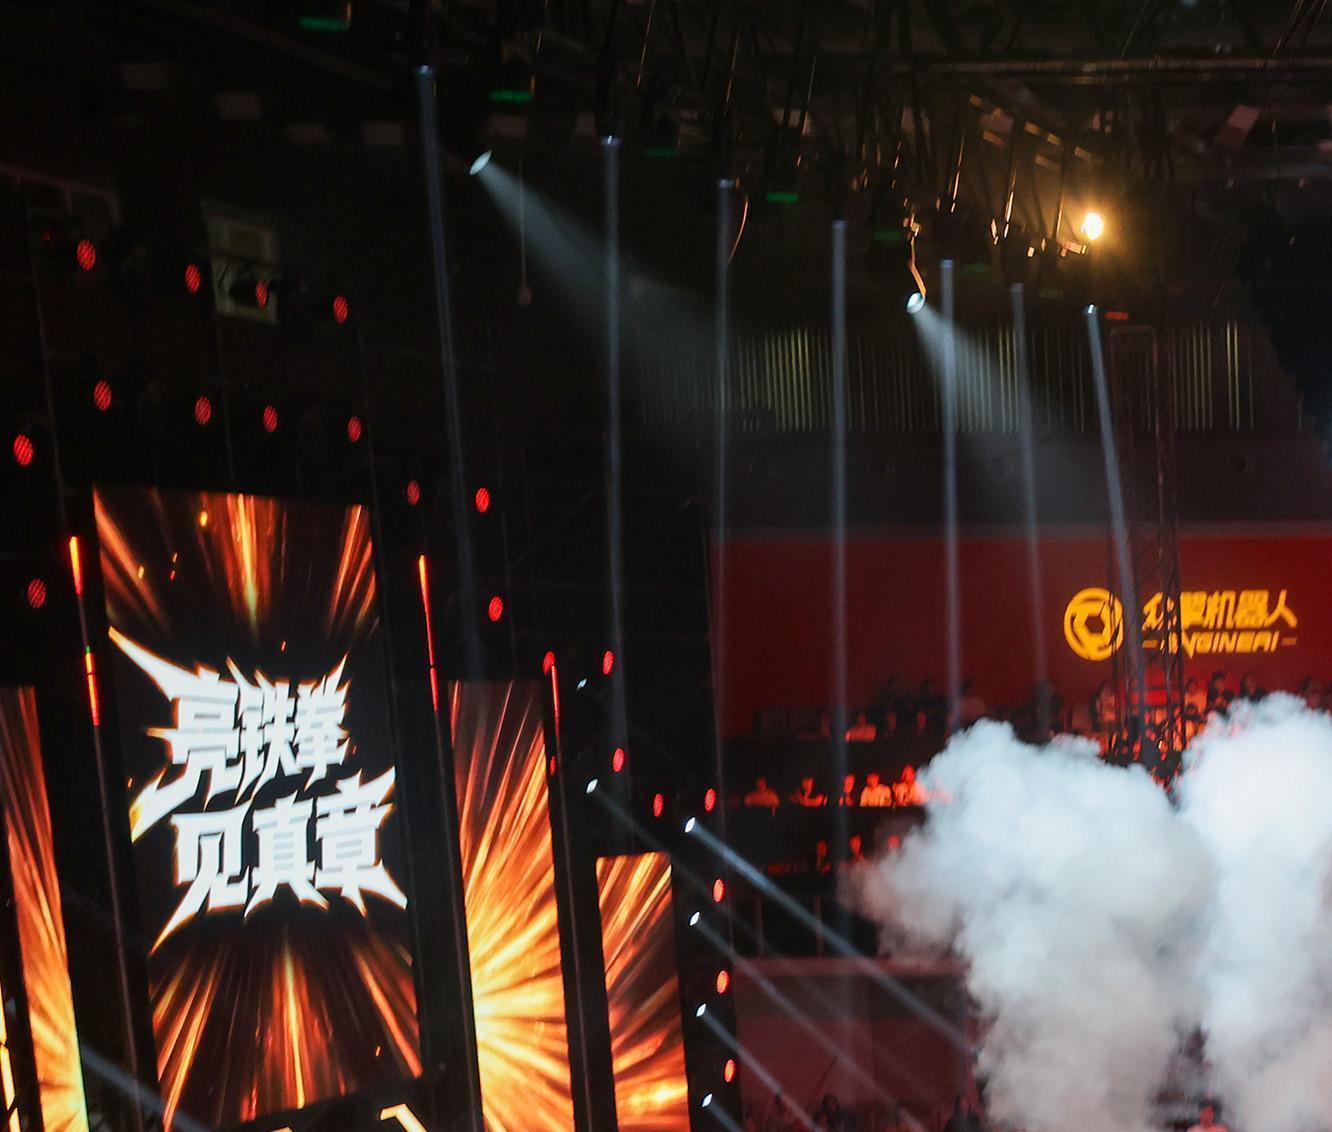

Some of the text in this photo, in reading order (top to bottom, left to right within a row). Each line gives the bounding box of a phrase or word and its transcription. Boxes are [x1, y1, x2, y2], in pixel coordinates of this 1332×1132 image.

[108, 626, 350, 843] 亮铁拳
[149, 767, 408, 955] 见真章
